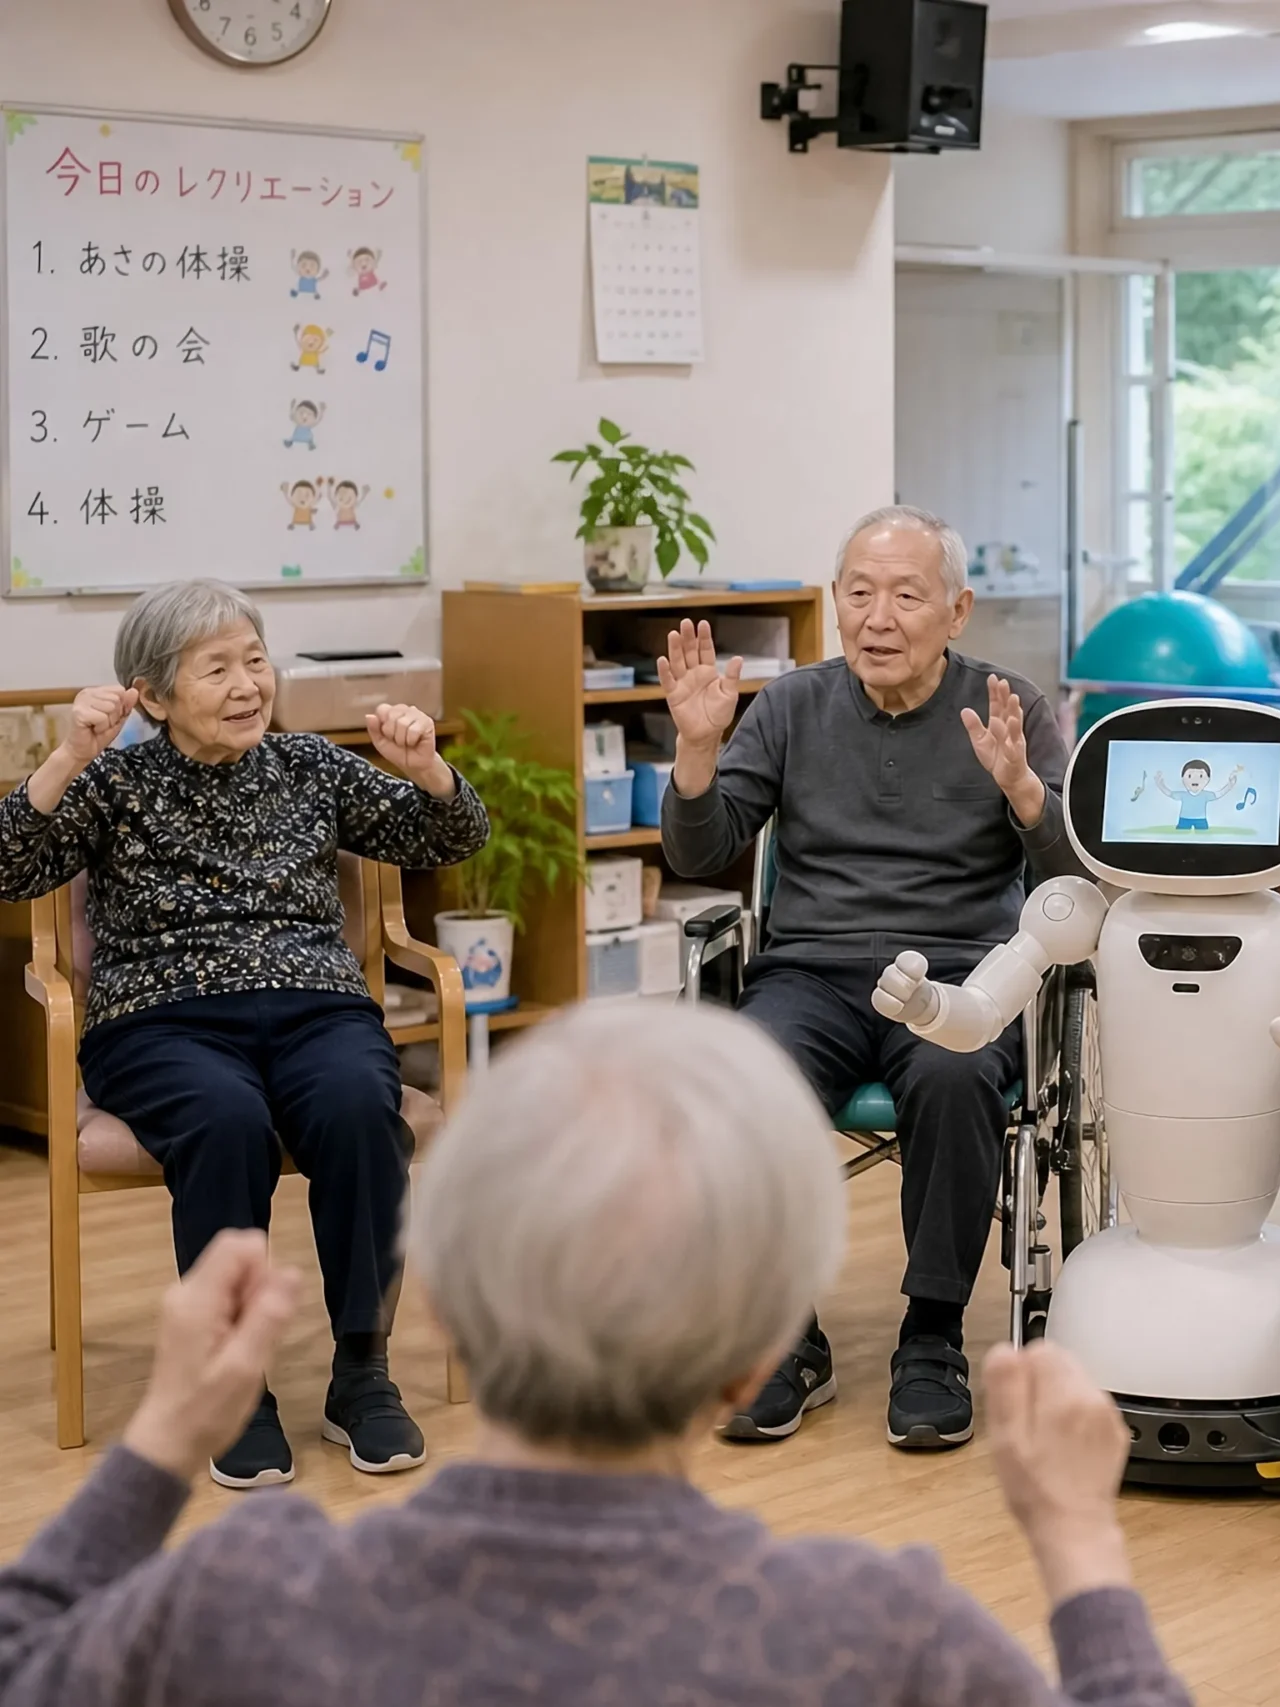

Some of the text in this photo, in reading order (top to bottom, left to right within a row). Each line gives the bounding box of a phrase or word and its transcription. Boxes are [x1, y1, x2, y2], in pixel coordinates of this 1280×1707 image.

[219, 16, 232, 36] 7
[289, 2, 301, 20] 4
[244, 26, 257, 46] 6
[271, 22, 283, 41] 5
[46, 146, 395, 208] 今日のレクリエーション
[32, 240, 251, 282] 1. あさの体操
[31, 326, 210, 365] 2. 歌の会
[30, 408, 190, 443] 3. ゲーム
[28, 486, 167, 525] 4. 体操
